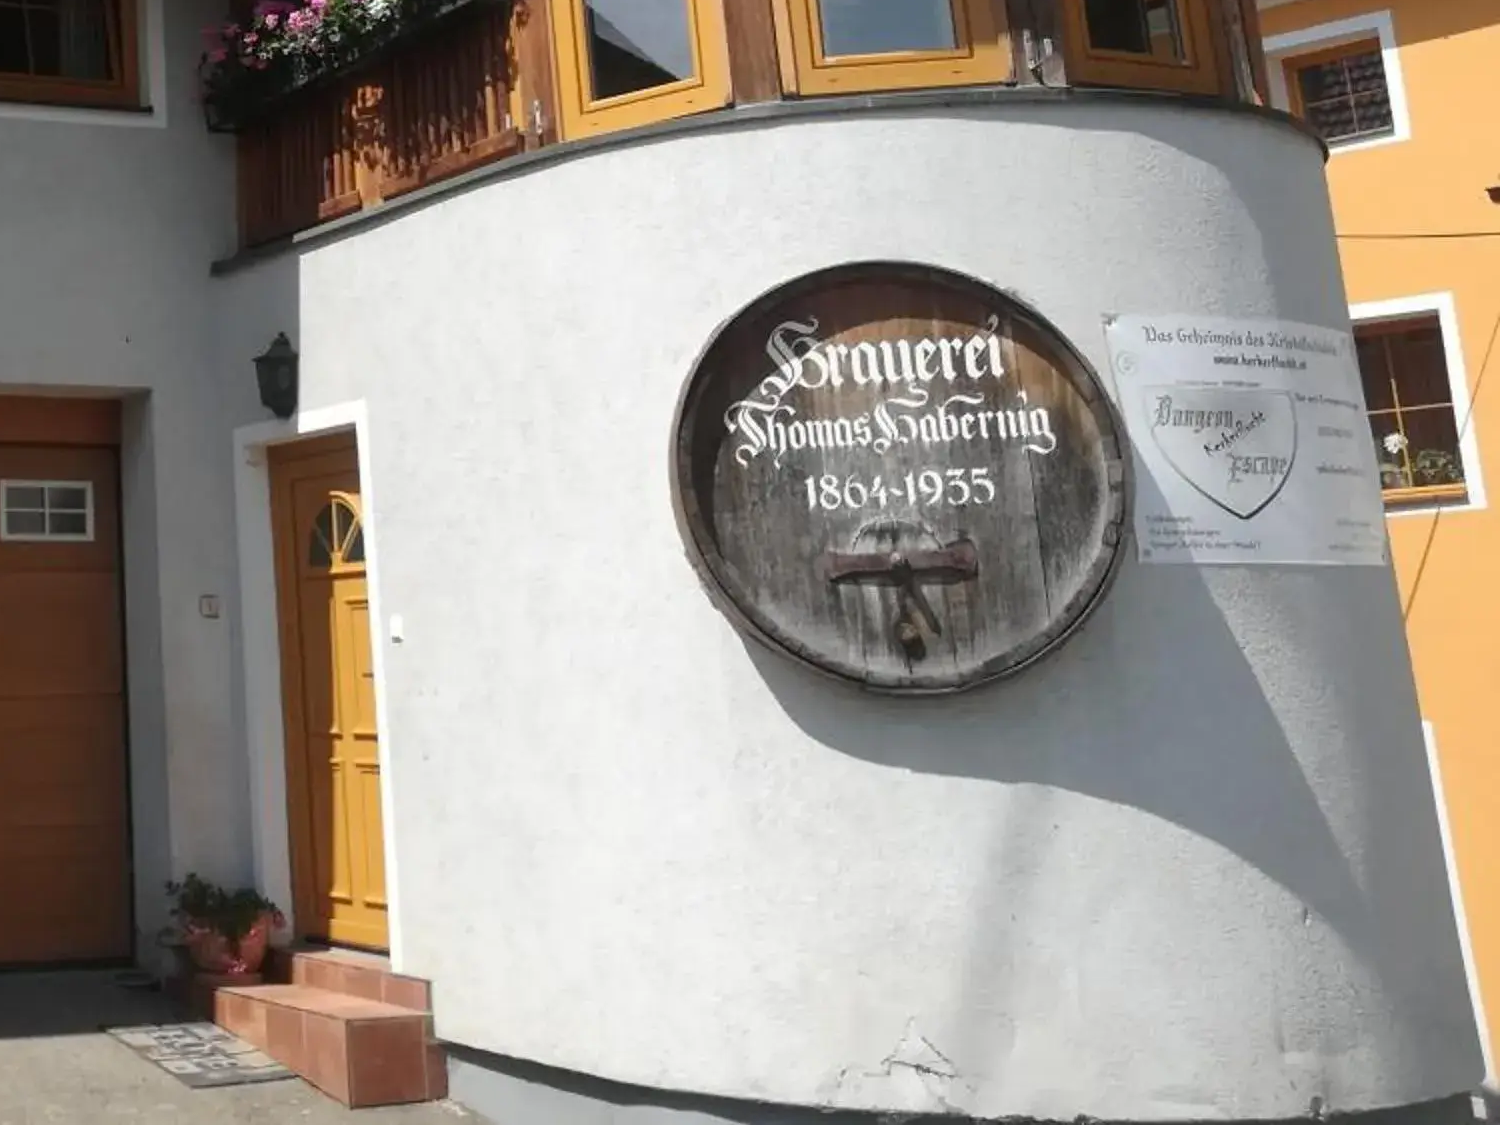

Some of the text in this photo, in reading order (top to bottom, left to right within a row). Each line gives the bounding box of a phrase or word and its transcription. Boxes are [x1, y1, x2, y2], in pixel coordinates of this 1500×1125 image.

[760, 315, 1005, 397] Brauerei
[1142, 325, 1173, 344] Das
[1177, 327, 1243, 349] Geheimnis
[1245, 331, 1265, 347] des
[724, 383, 1057, 469] Thomas Habernig
[1155, 394, 1234, 434] Dungeon
[804, 467, 996, 511] 1864-1935
[1227, 452, 1288, 486] Escape
